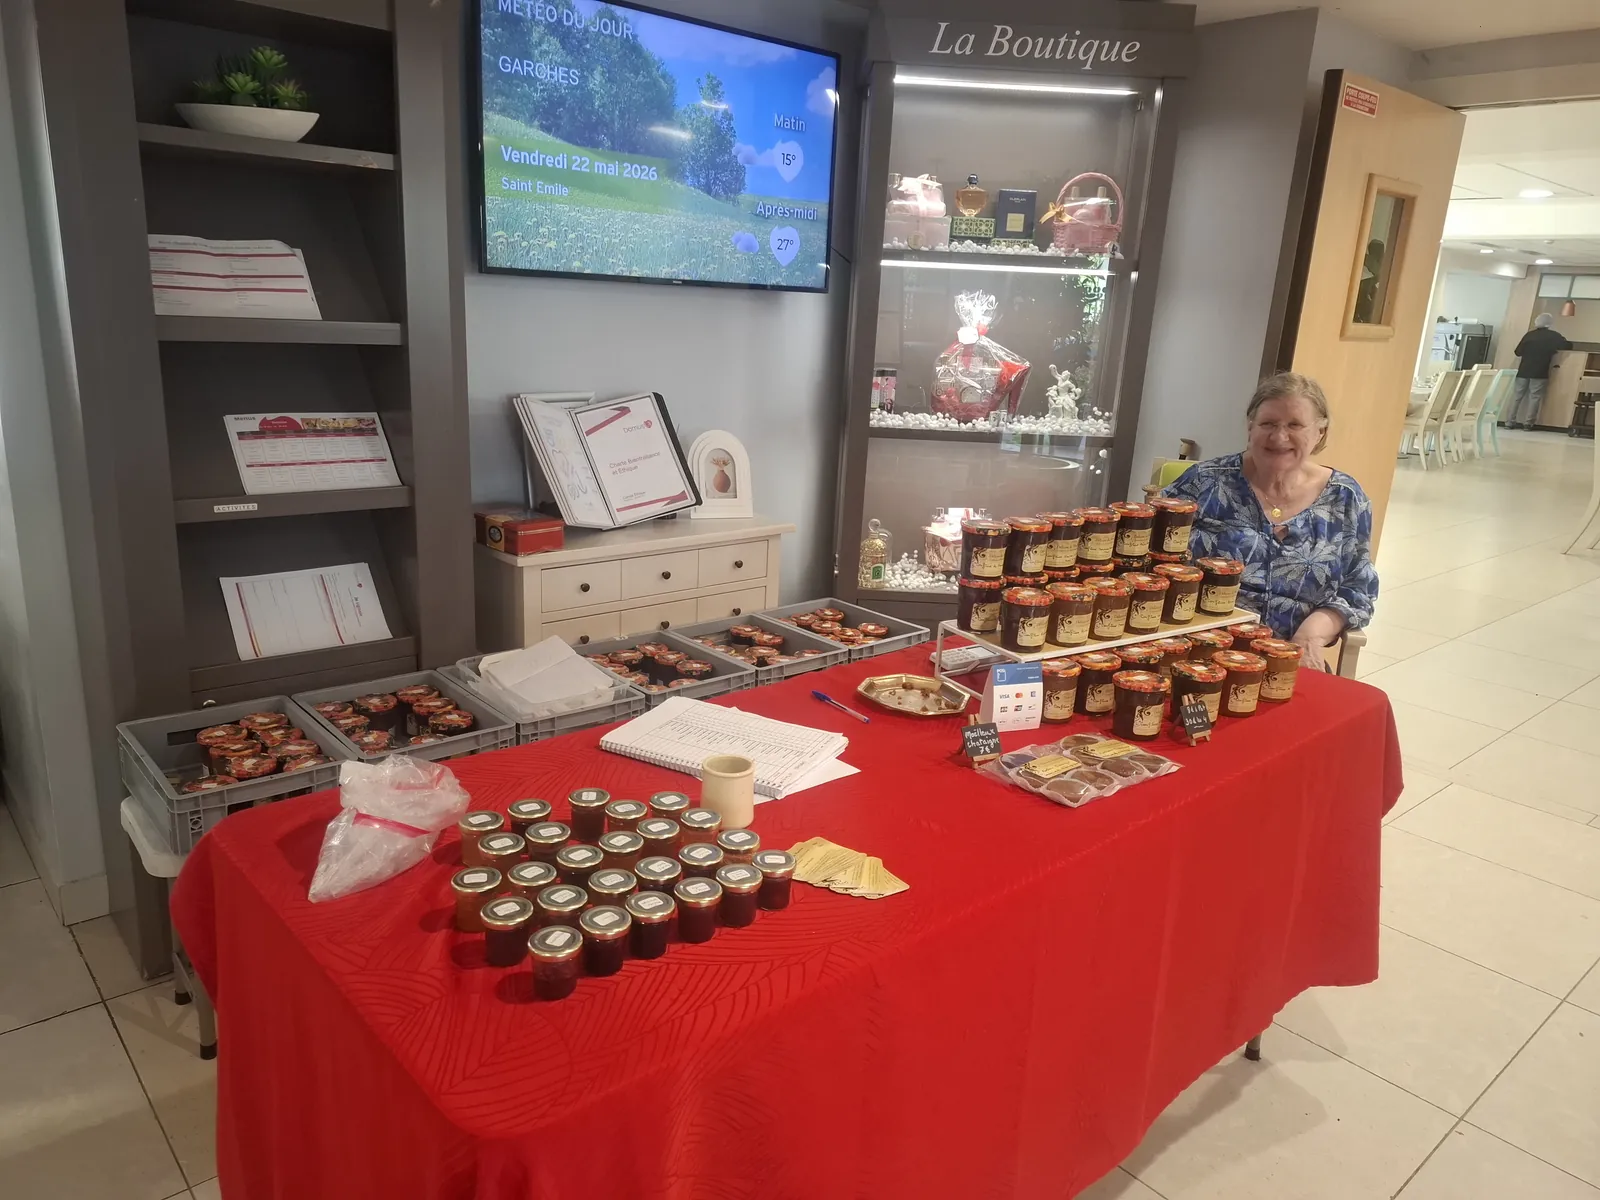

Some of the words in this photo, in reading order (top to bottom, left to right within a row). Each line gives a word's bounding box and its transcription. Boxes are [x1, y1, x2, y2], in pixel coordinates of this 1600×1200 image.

[563, 9, 585, 29] DU
[590, 16, 633, 40] JOUR
[928, 22, 976, 56] La
[984, 24, 1141, 70] Boutique
[499, 55, 579, 85] GARCHES
[773, 113, 806, 132] Matin
[501, 144, 569, 170] Vendredi
[571, 155, 591, 172] 22
[594, 160, 619, 177] mai
[622, 162, 659, 181] 2026
[781, 152, 797, 166] 15°
[501, 177, 533, 193] Saint
[536, 181, 569, 197] Emile
[756, 201, 818, 221] Après-midi
[777, 238, 794, 252] 27°
[215, 503, 257, 512] ACTIVITES
